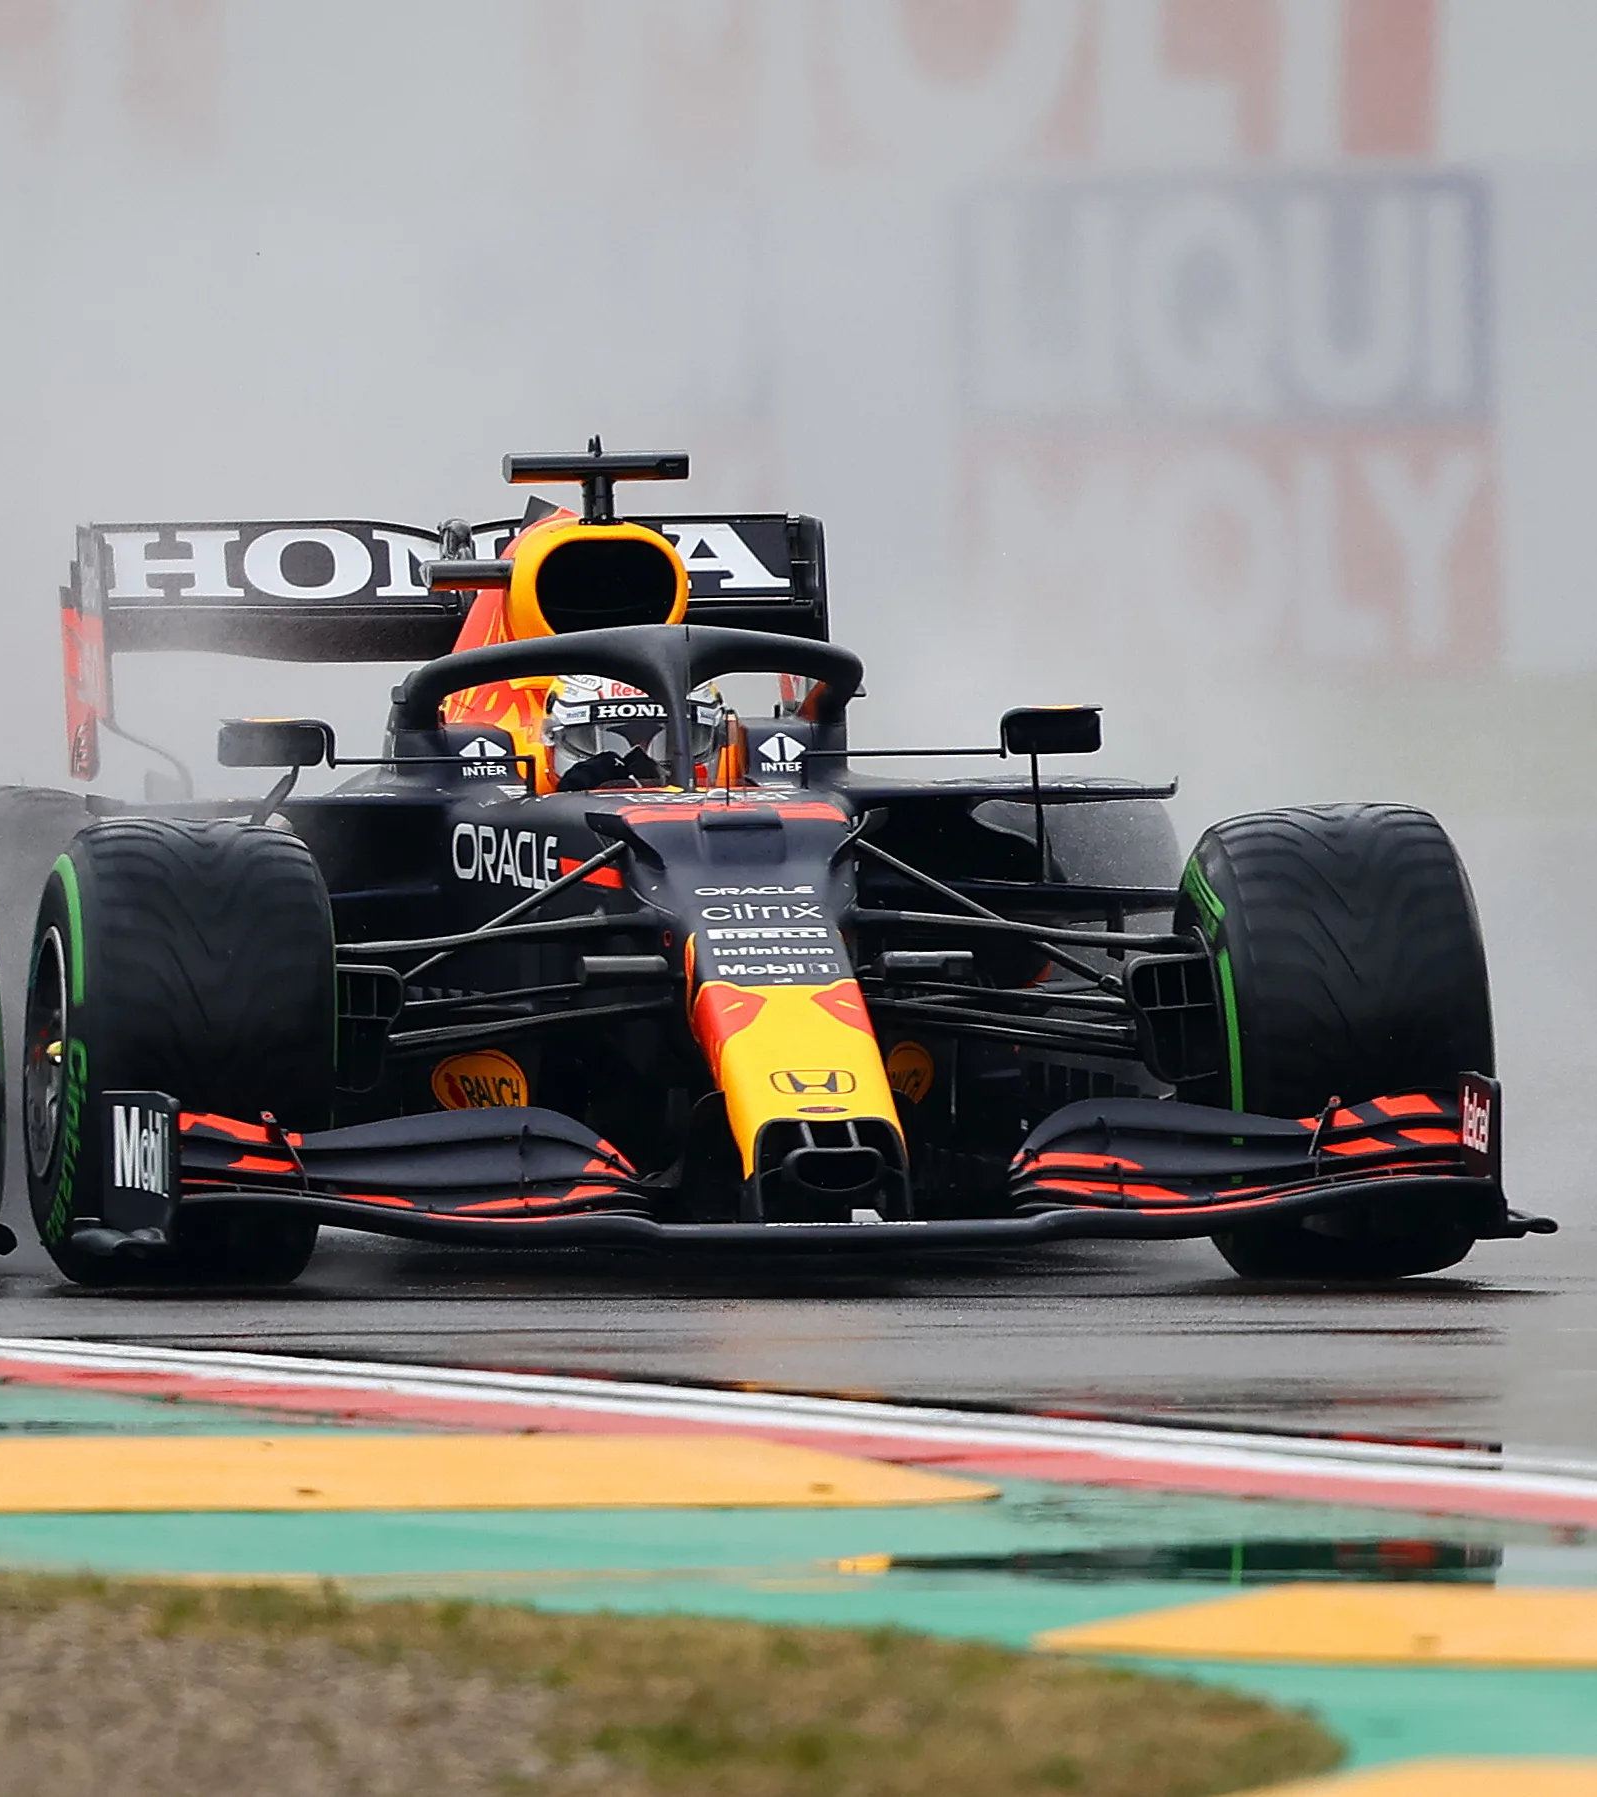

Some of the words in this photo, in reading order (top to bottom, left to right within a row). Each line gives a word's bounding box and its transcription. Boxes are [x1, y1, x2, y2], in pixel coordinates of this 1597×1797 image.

[983, 196, 1467, 412] LIQUI
[106, 523, 790, 599] HONA
[991, 453, 1481, 655] MOLY
[597, 704, 668, 718] HON
[462, 766, 507, 776] INTER
[453, 823, 558, 890] ORACLE
[694, 886, 815, 896] ORACLE
[707, 927, 828, 940] PIRELLI
[718, 963, 804, 976] Mobil
